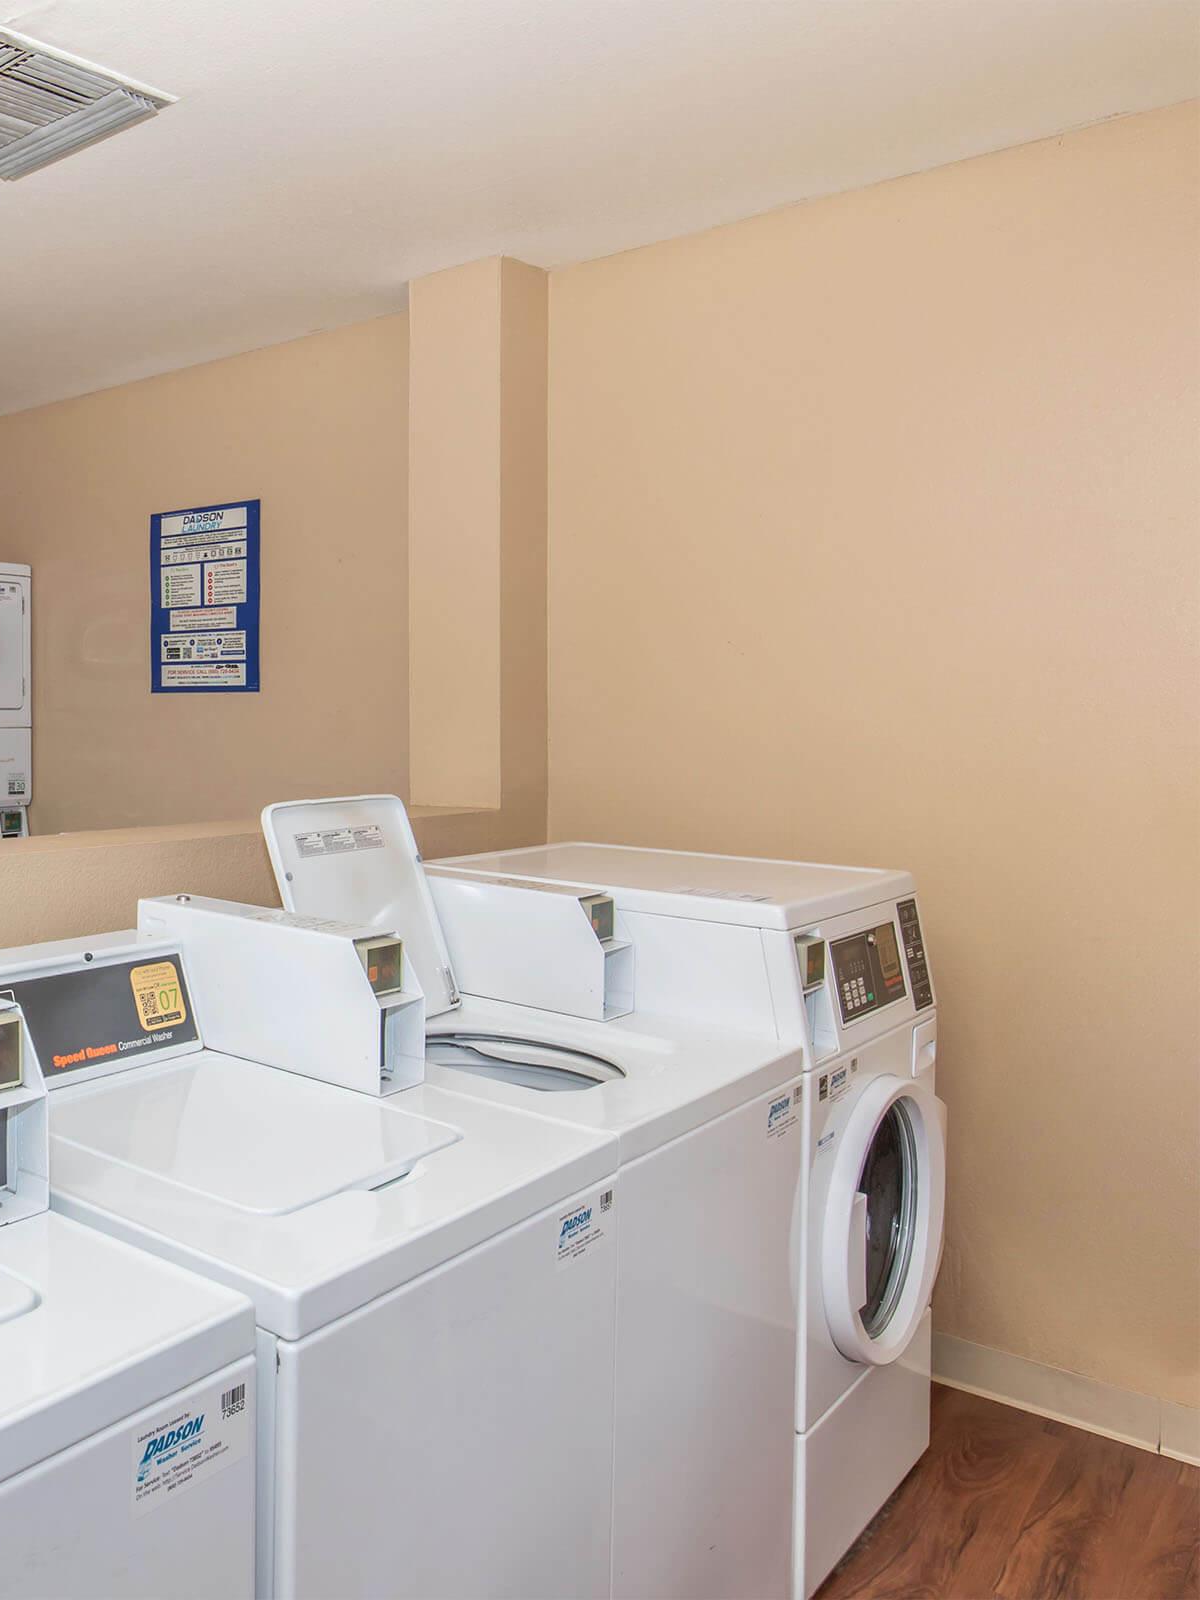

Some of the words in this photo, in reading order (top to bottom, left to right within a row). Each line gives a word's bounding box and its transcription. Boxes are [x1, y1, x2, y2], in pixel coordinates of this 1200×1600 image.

[182, 521, 222, 532] LAUNDRY
[183, 511, 224, 525] DADSON
[16, 782, 26, 791] 30
[159, 988, 178, 1010] 07
[53, 1049, 86, 1068] Speed
[85, 1043, 118, 1059] Queen
[118, 1036, 151, 1051] Commercial
[151, 1030, 173, 1043] Washer
[768, 1097, 791, 1118] DADSON
[560, 1207, 592, 1237] DADSON
[221, 1400, 245, 1420] 73652
[137, 1430, 155, 1443] Laundry
[143, 1414, 205, 1463] DADSON
[156, 1450, 178, 1466] Washer
[180, 1437, 202, 1452] Service
